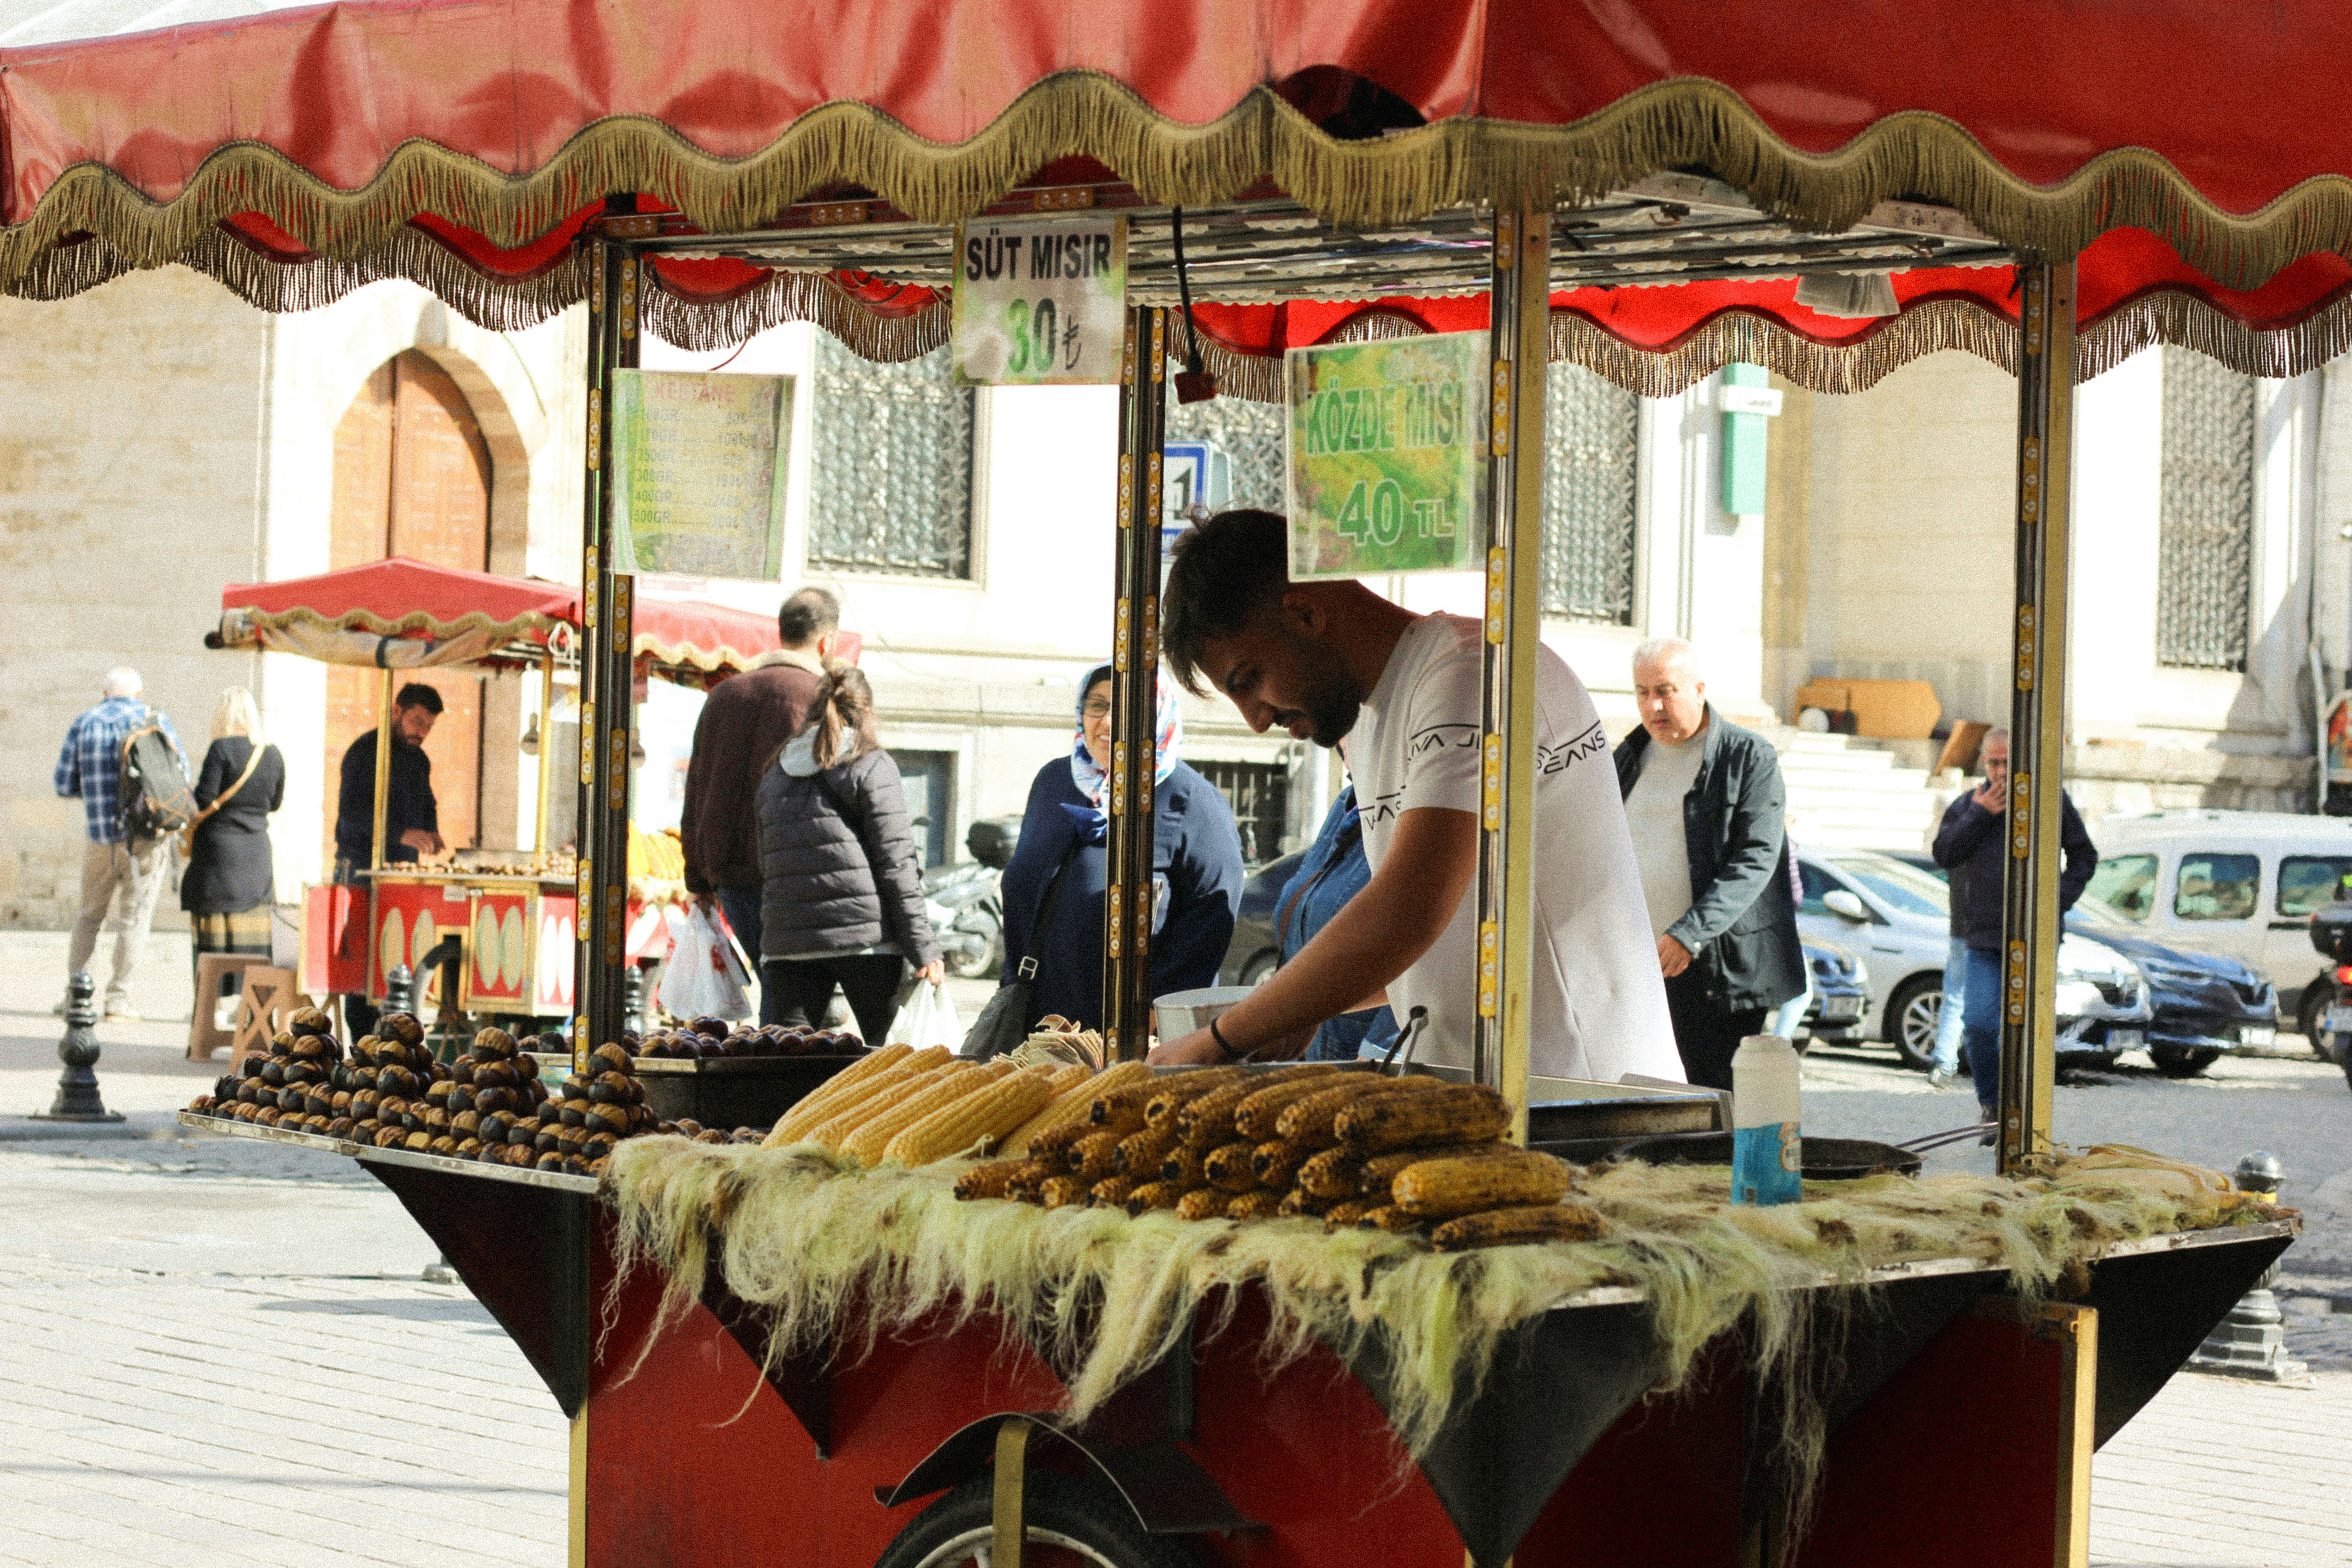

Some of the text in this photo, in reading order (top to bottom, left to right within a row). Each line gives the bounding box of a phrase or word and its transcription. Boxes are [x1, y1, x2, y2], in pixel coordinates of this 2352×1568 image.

[966, 228, 1111, 280] SÜT MISIR
[1306, 376, 1397, 456] KÖZDE
[1338, 479, 1455, 546] 40 TL
